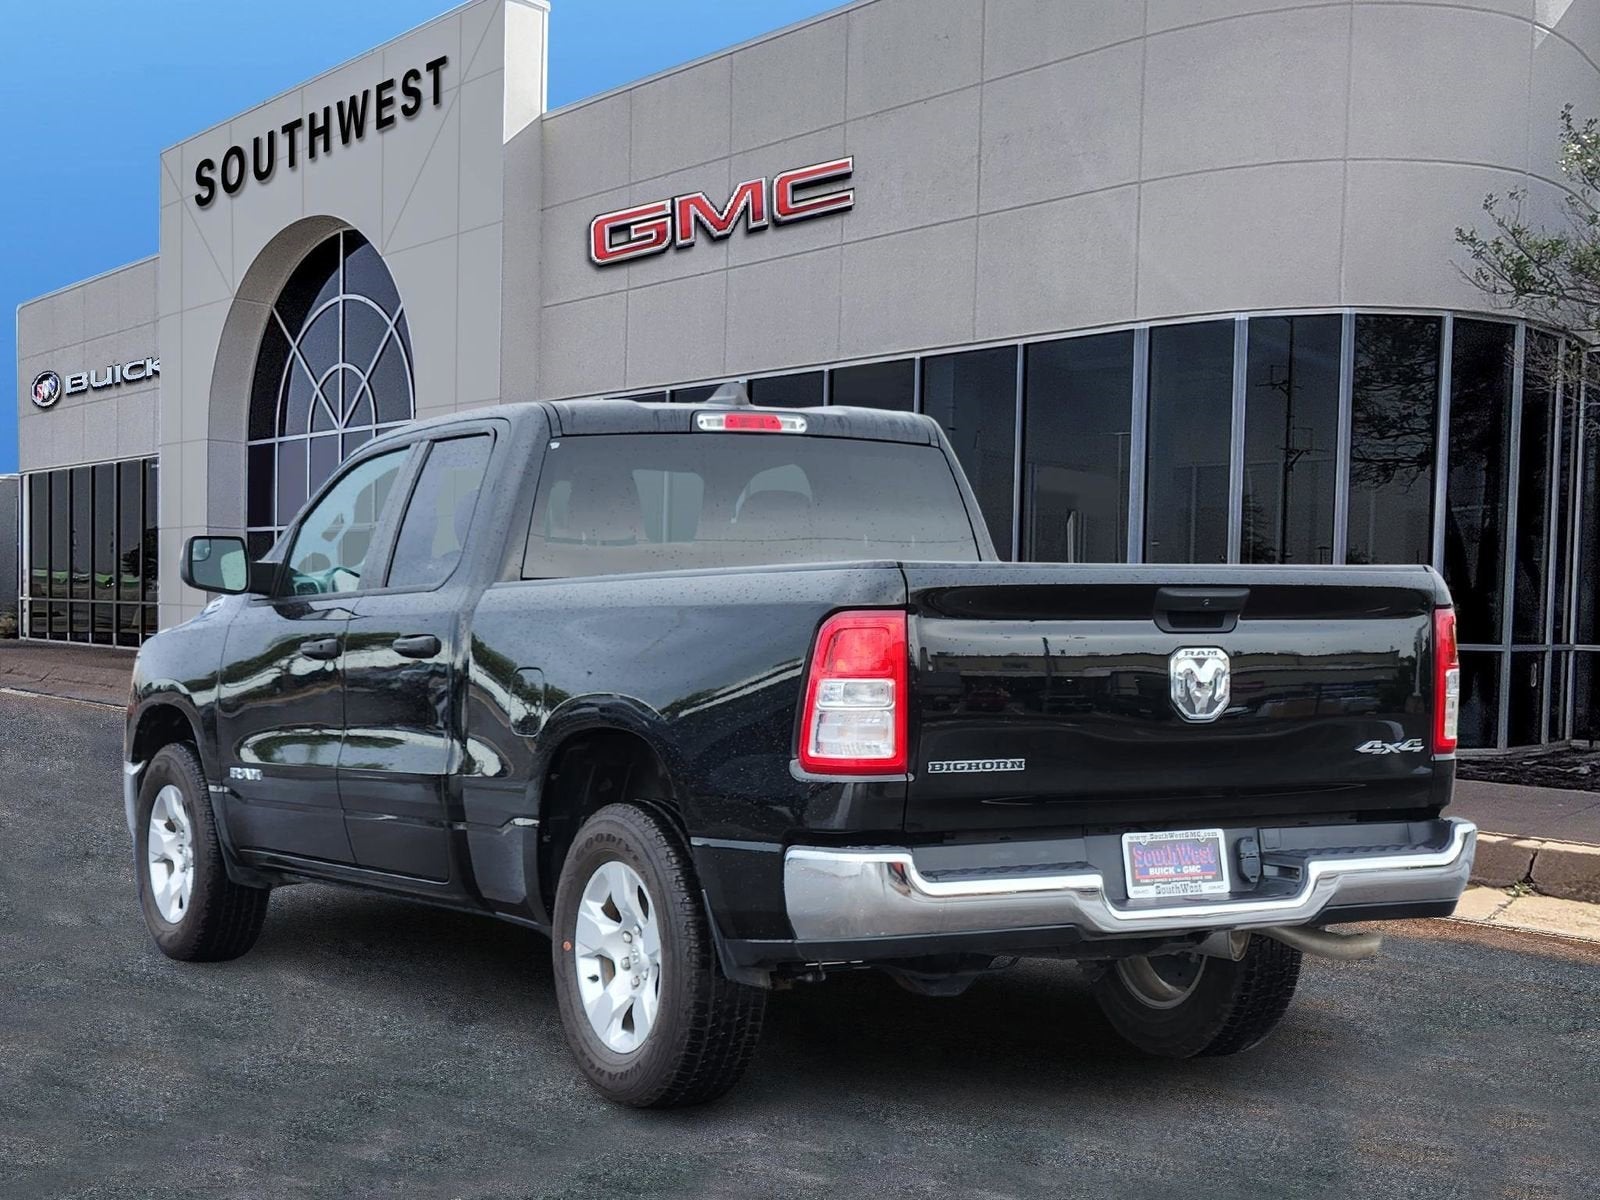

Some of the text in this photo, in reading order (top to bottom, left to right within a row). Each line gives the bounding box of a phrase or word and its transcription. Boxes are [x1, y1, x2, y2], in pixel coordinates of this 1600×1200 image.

[194, 55, 449, 208] SOUTHWEST
[588, 155, 855, 266] GMC
[64, 357, 160, 395] BUICK
[229, 767, 263, 781] RAM
[928, 759, 1026, 774] BIGHORN
[1133, 842, 1216, 867] SouthWest
[1149, 865, 1202, 876] BUICK GMC
